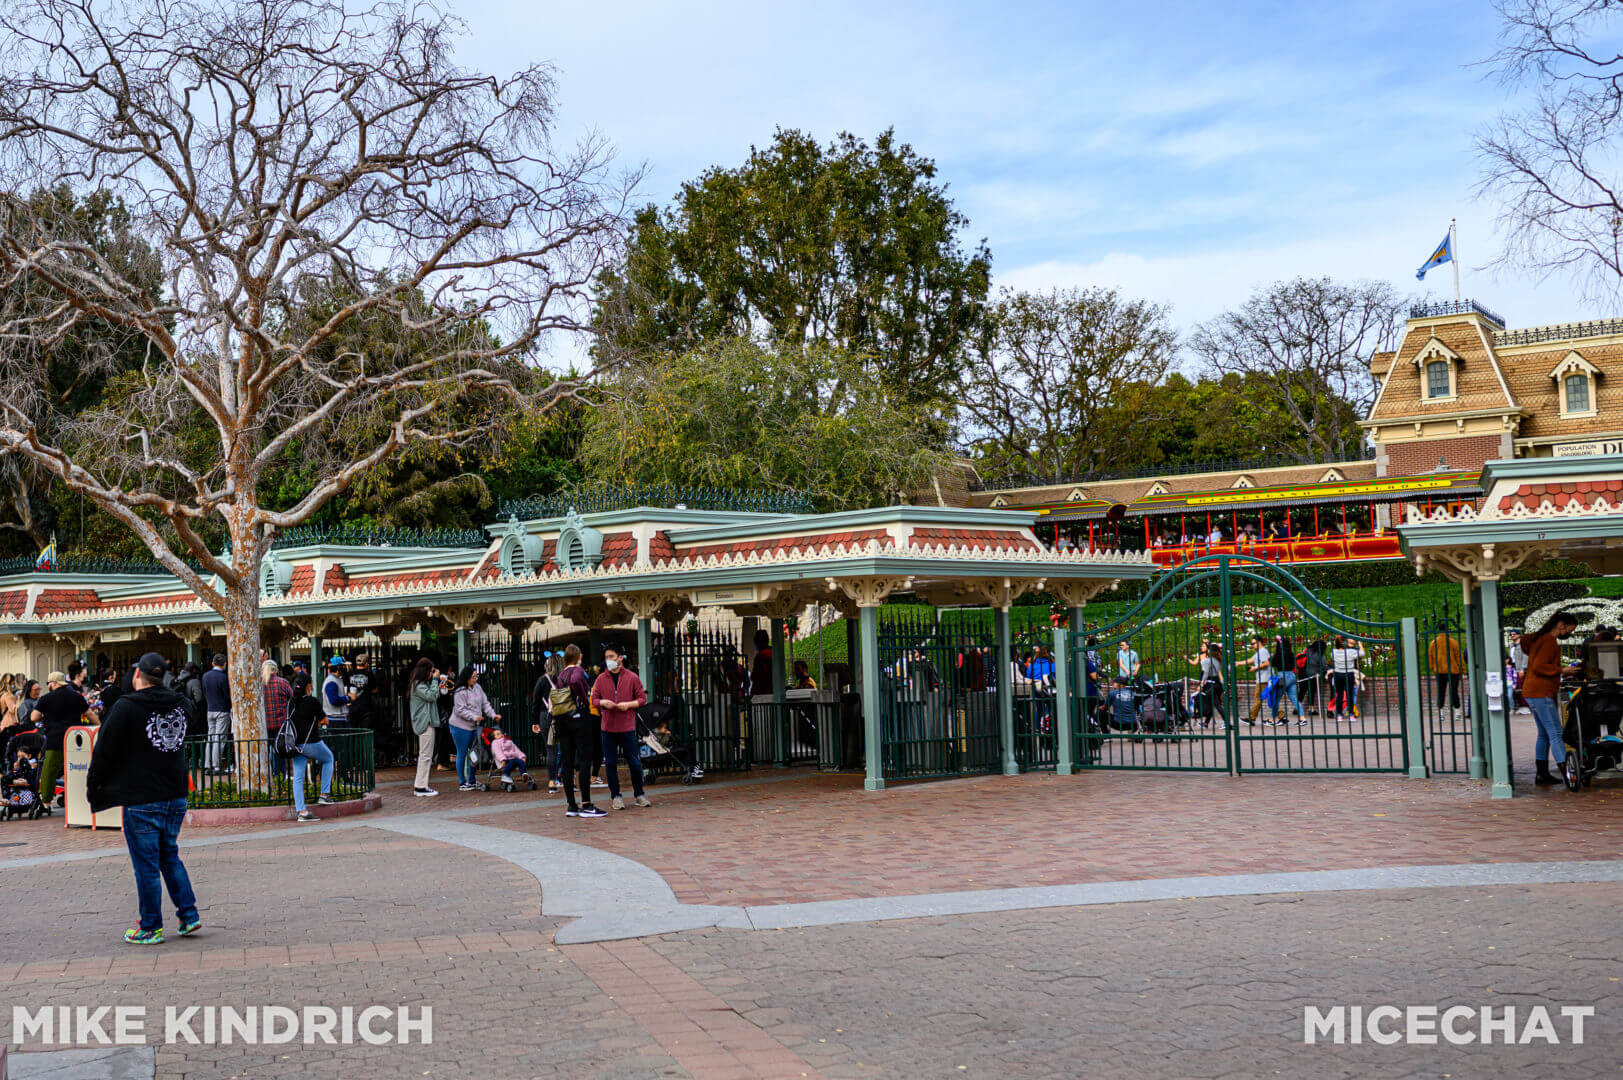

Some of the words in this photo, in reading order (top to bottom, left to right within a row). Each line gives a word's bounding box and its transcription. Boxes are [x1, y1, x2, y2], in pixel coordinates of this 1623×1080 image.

[1557, 444, 1597, 452] POPULATION
[1199, 491, 1312, 502] DISNEYLAND
[1338, 482, 1439, 493] RAILROAD
[1537, 531, 1545, 540] 17
